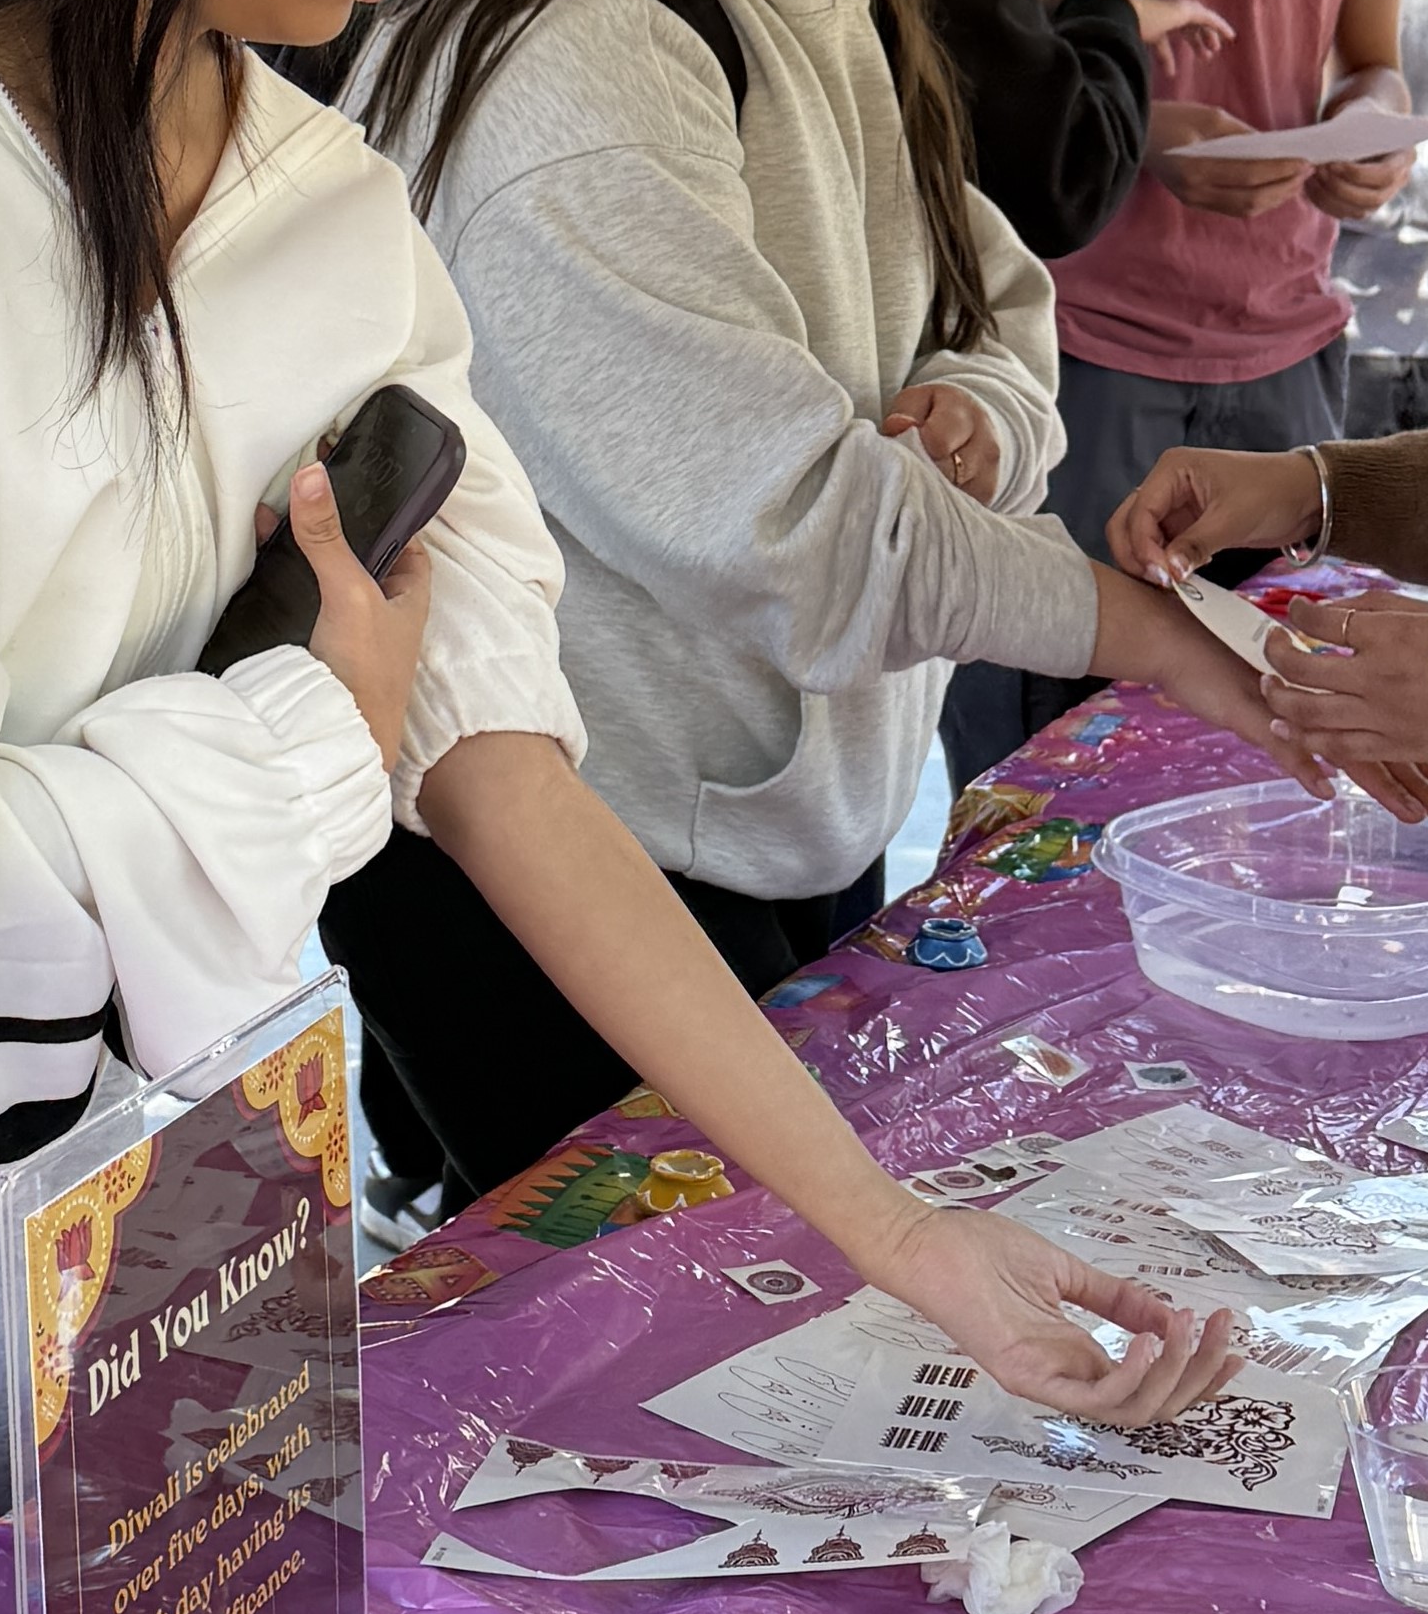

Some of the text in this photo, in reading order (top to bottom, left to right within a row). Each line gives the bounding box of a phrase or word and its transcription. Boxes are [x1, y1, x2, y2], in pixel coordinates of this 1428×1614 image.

[88, 1197, 310, 1417] Did You Know?
[109, 1359, 311, 1559] Diwali is celebrated
[168, 1518, 208, 1570] five
[211, 1473, 264, 1531] days,
[266, 1423, 312, 1480] with
[217, 1503, 285, 1587] having
[287, 1483, 312, 1522] its
